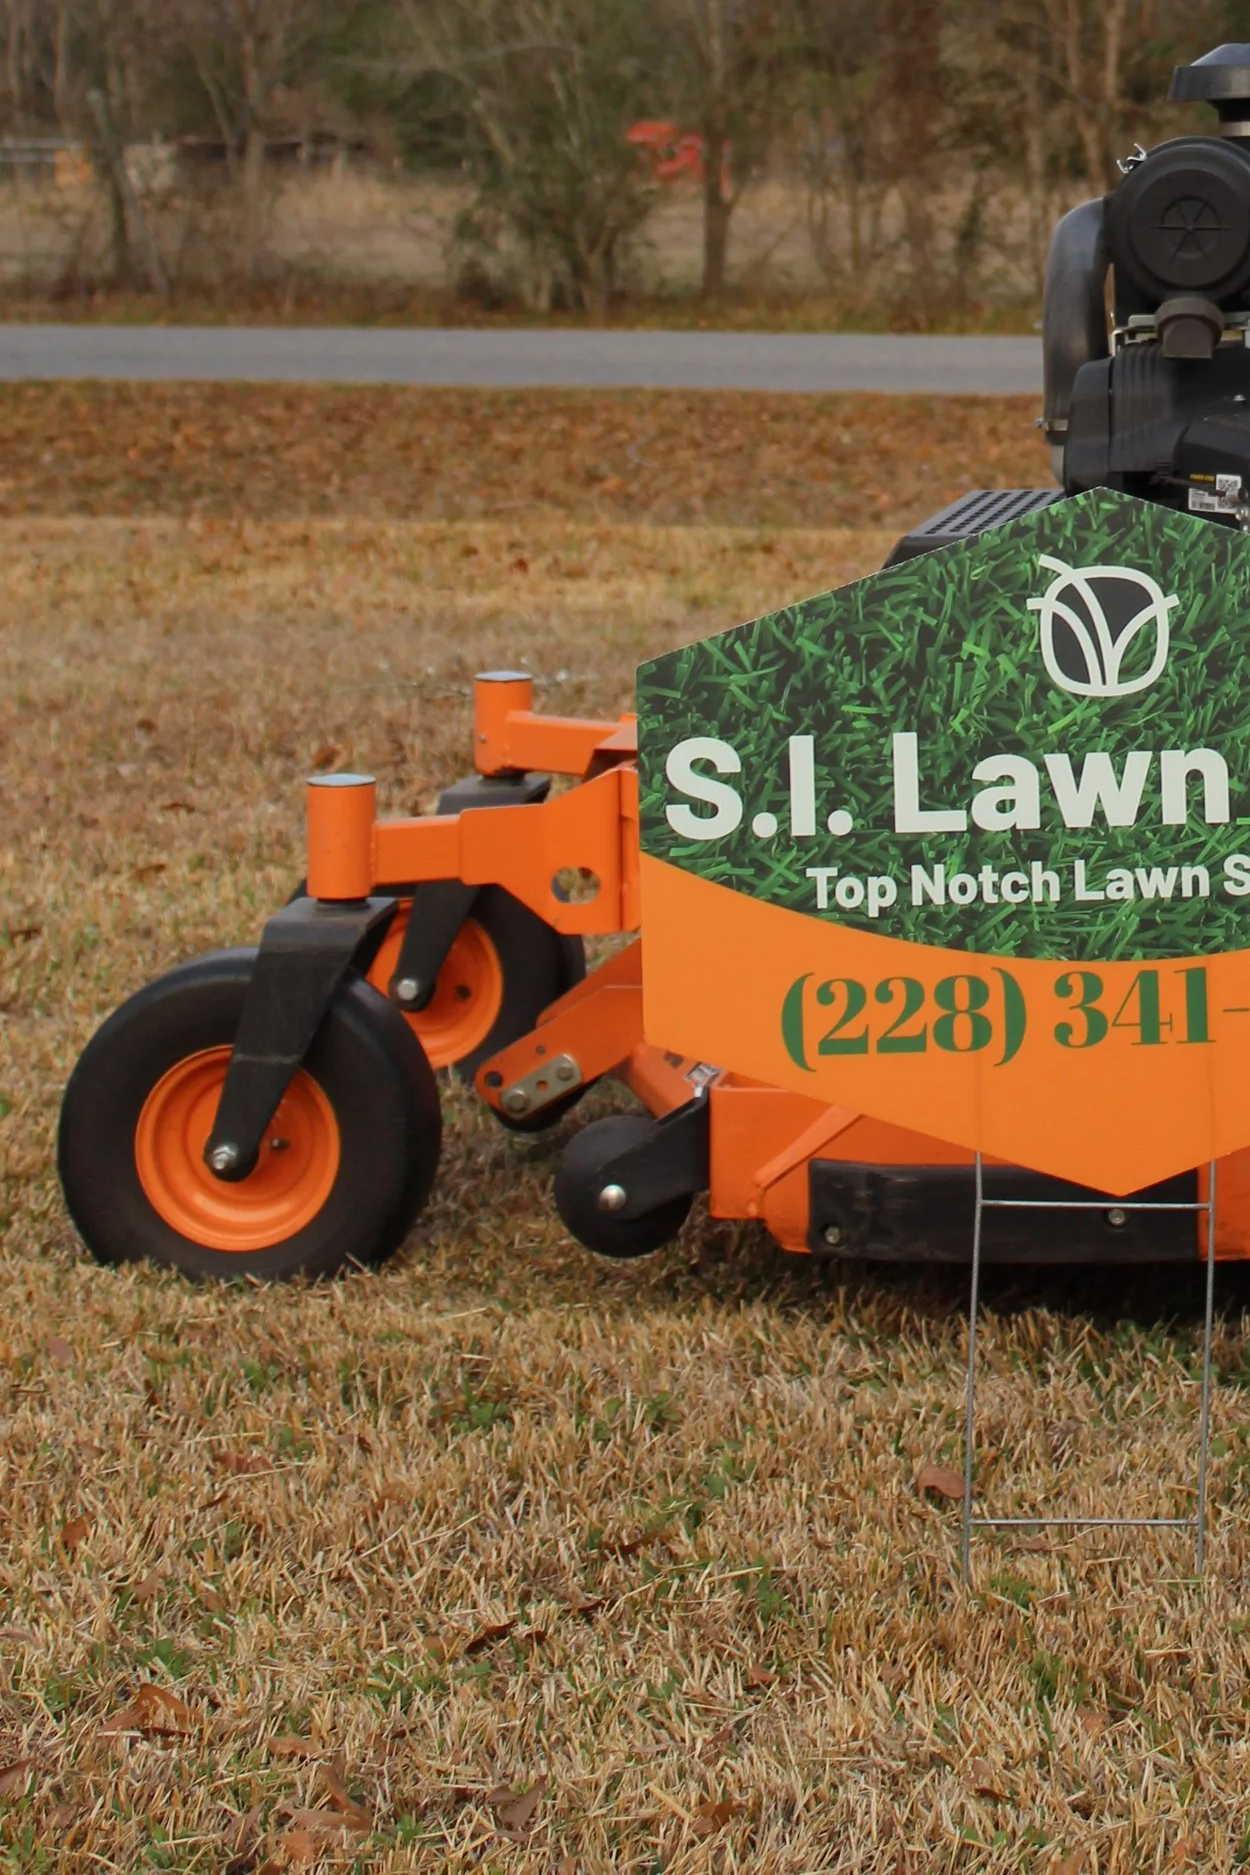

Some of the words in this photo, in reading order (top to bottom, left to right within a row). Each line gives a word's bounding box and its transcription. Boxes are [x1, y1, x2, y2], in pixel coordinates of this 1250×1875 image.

[664, 733, 855, 842] S.I.
[892, 731, 1231, 834] Lawn
[804, 865, 898, 919] Top
[910, 859, 1061, 908] Notch
[1073, 857, 1211, 903] Lawn
[780, 967, 1028, 1072] (228)
